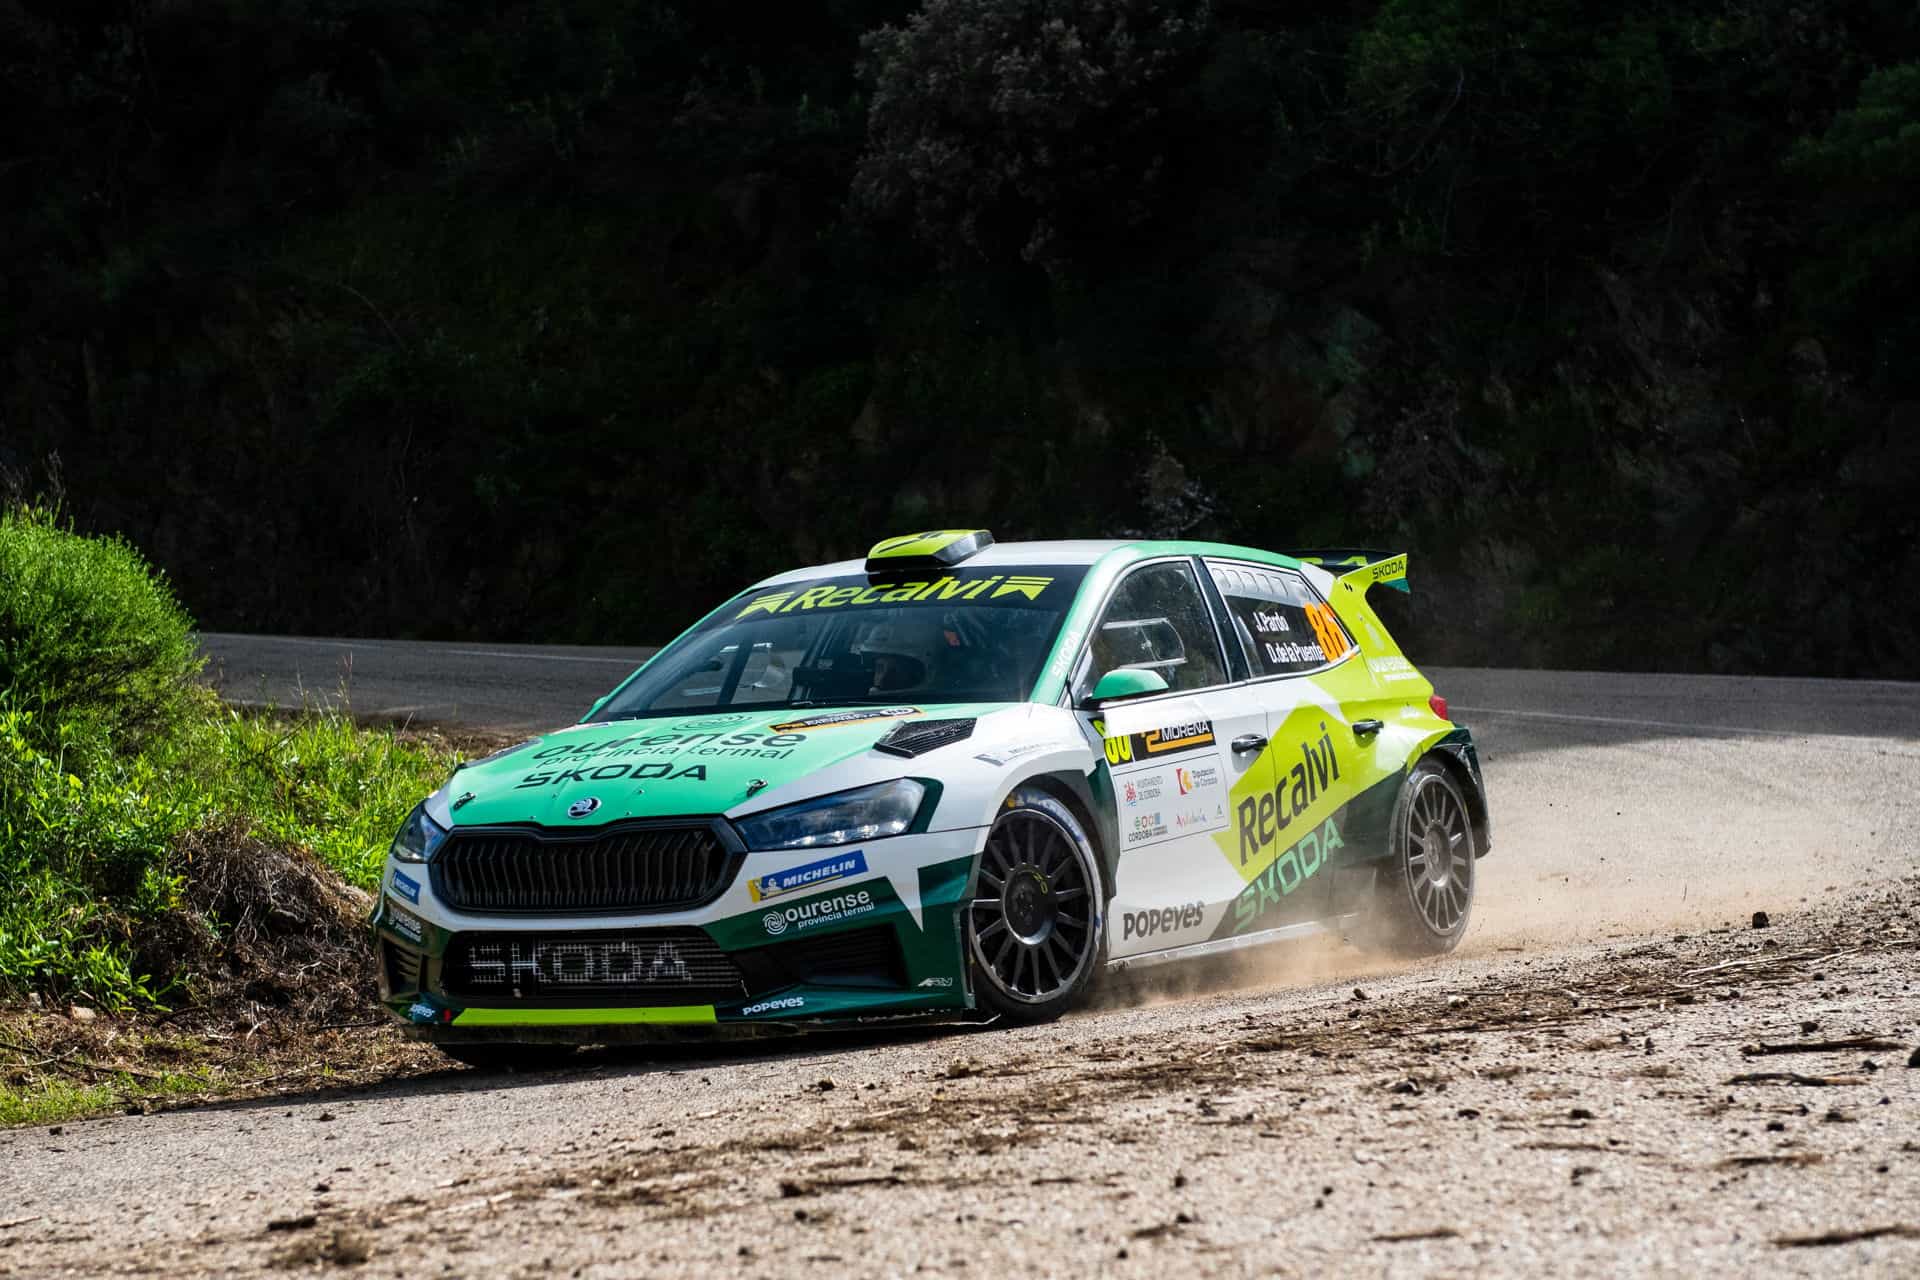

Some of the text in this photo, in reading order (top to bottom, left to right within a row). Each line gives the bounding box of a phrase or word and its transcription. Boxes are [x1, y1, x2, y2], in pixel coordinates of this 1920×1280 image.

[780, 576, 1004, 614] Recalvi
[532, 732, 808, 761] ourense
[535, 746, 795, 769] provincia termal
[514, 763, 707, 790] SKODA
[1237, 721, 1341, 867] Recalvi
[783, 859, 856, 888] MICHELIN
[785, 890, 870, 923] ourense
[798, 902, 875, 930] provincia termal
